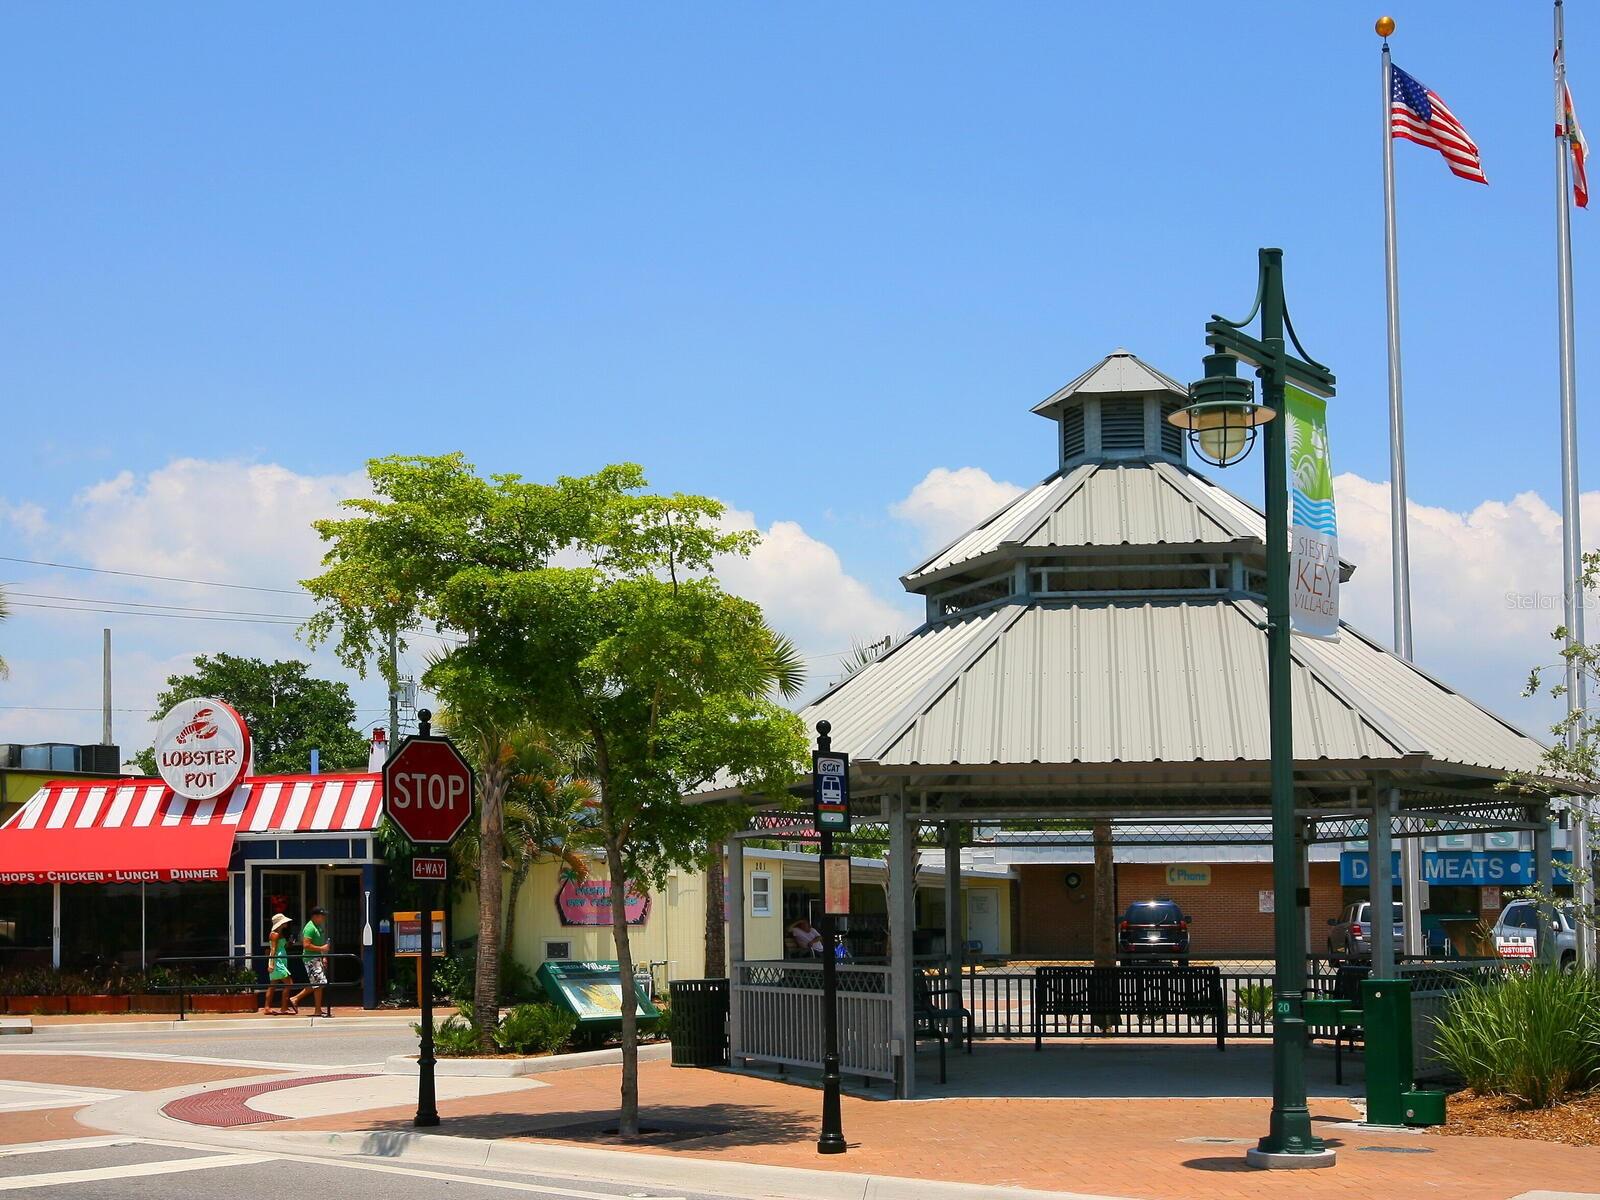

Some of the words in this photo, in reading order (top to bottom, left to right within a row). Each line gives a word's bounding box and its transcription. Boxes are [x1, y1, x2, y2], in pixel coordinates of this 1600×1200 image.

[1299, 537, 1334, 563] SIESTA
[1296, 559, 1335, 598] KEY
[1295, 593, 1334, 616] VILLAGE
[162, 749, 237, 767] LOBSTER
[822, 763, 840, 773] SCAT
[185, 772, 216, 788] POT
[393, 772, 465, 810] STOP
[0, 872, 35, 882] HOPS
[47, 870, 104, 881] CHICKEN
[115, 870, 159, 881] LUNCH
[170, 869, 218, 880] DINNER
[415, 863, 443, 875] 4-WAY
[1177, 869, 1207, 881] Phone
[1425, 858, 1504, 879] MEATS
[1500, 946, 1533, 954] CUSTOMER
[582, 962, 612, 972] Village
[1278, 1002, 1290, 1013] 20
